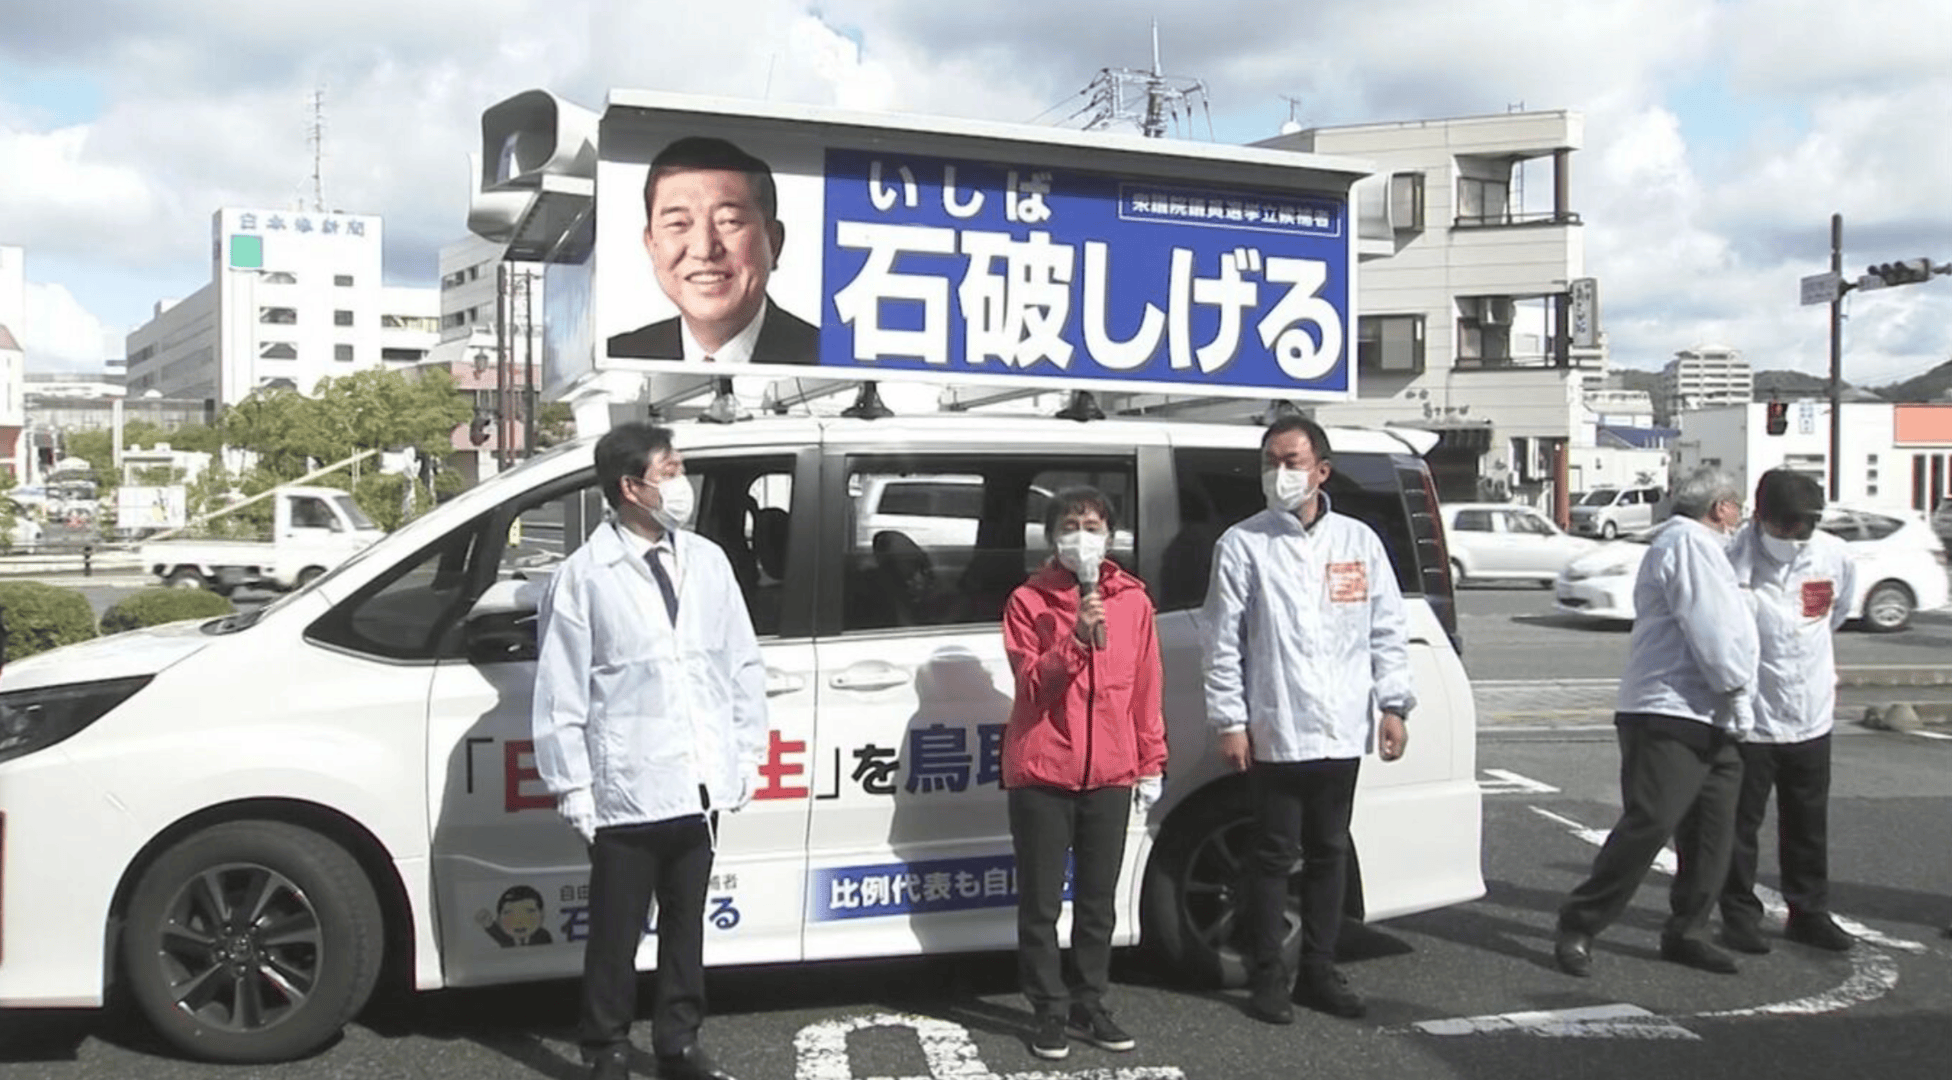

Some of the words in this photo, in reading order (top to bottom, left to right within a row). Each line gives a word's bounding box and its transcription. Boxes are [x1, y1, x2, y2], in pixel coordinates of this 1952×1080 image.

[868, 160, 1052, 223] いしば
[833, 219, 1342, 380] 石破しげる
[829, 867, 1019, 909] 比例代表も自
